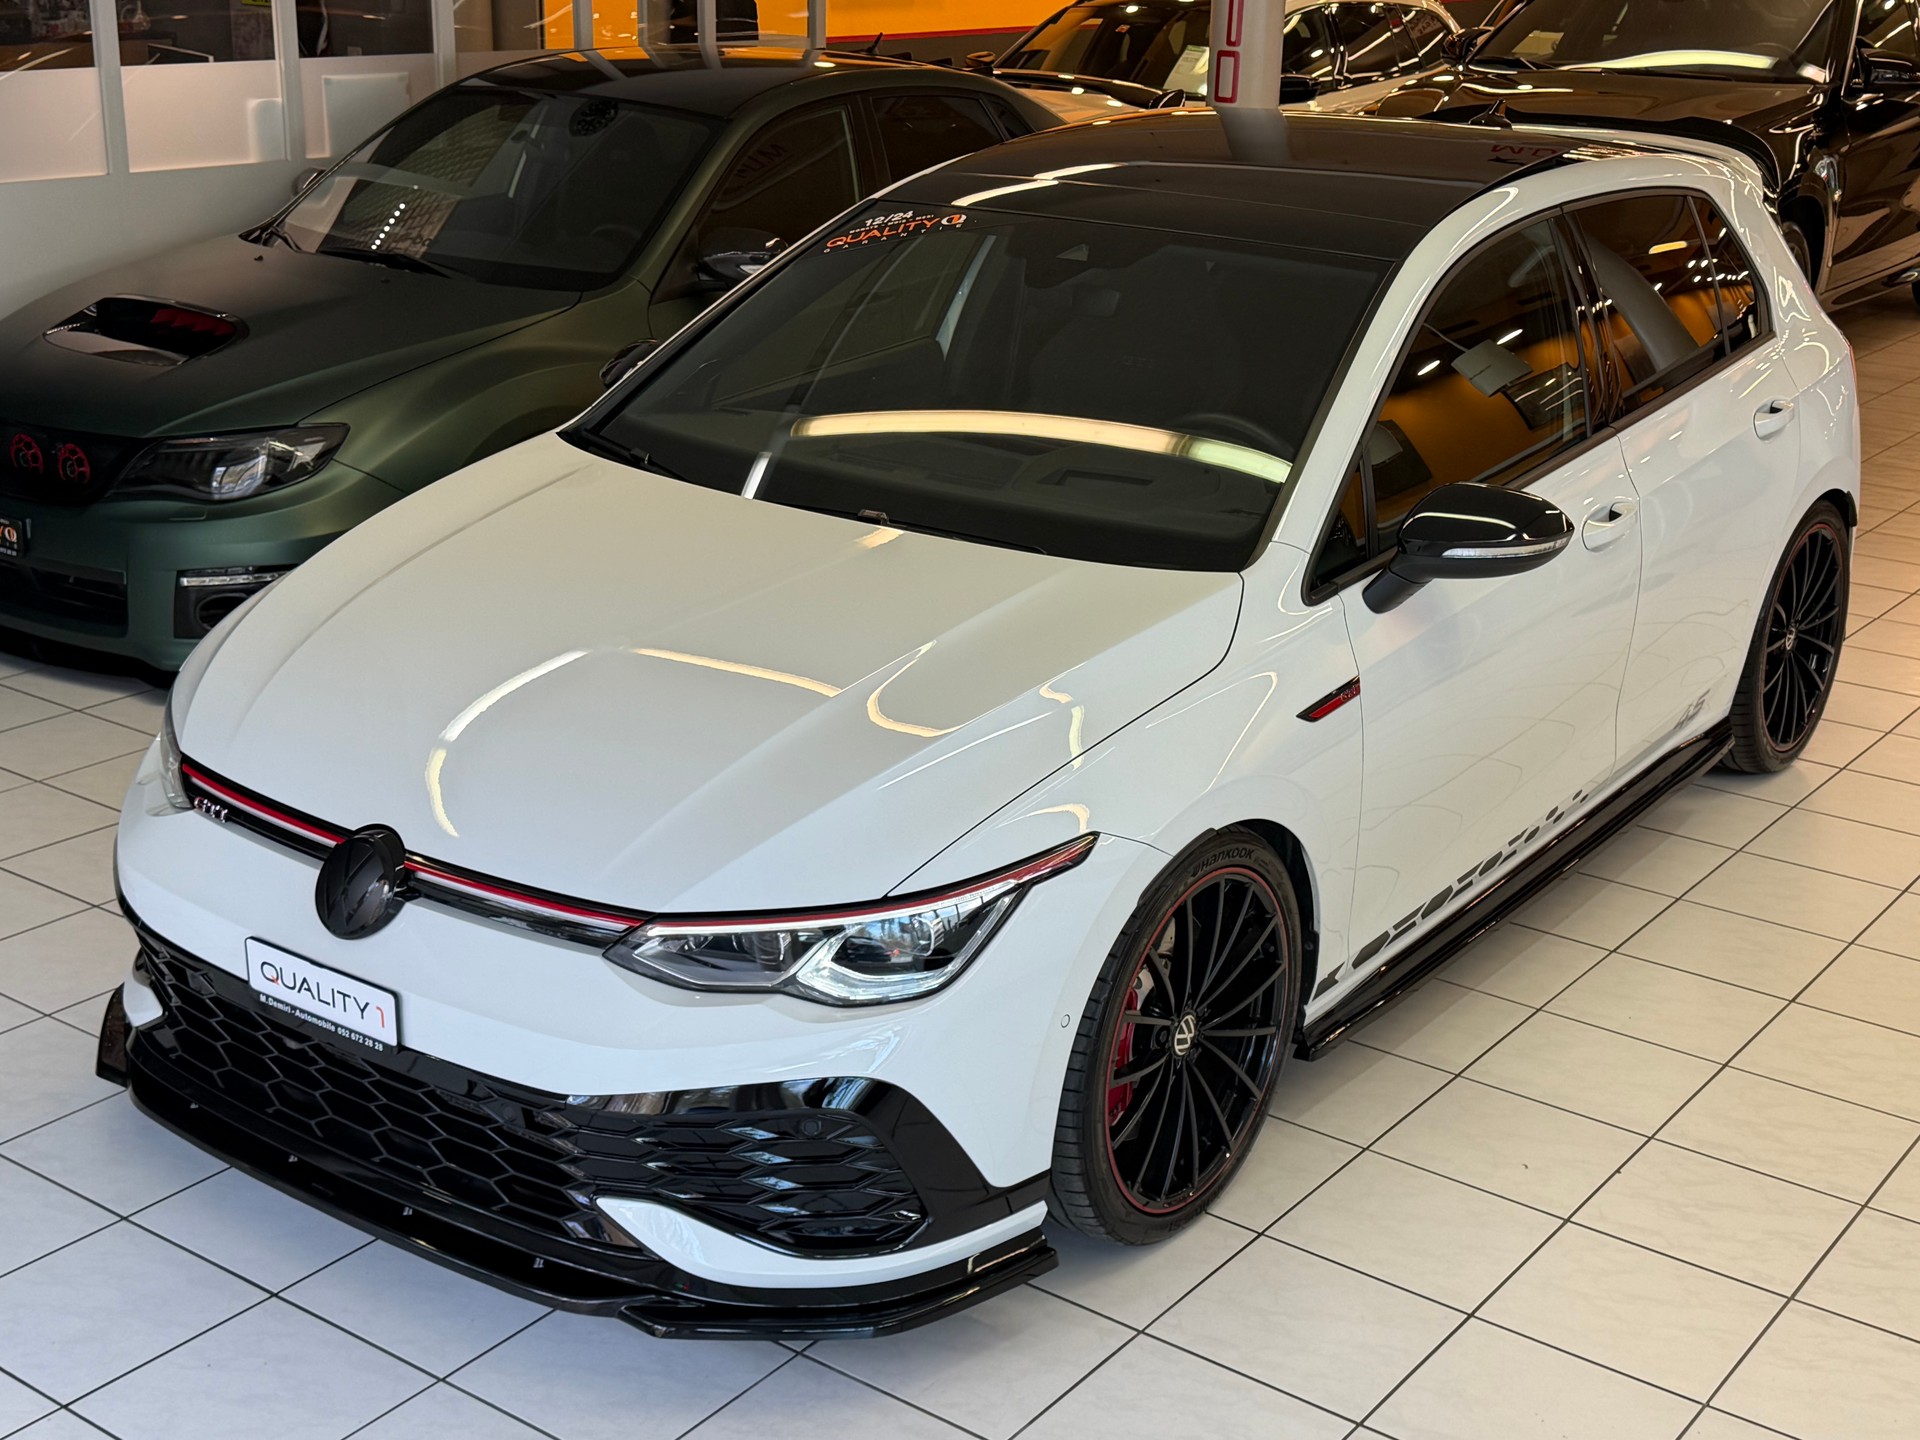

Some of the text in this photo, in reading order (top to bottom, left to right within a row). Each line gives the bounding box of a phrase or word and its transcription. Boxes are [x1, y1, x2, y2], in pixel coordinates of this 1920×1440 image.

[826, 217, 941, 248] QUALITY
[865, 210, 914, 227] 12/24
[260, 961, 370, 1020] QUALITY
[295, 1010, 336, 1033] Automobile
[374, 1041, 384, 1052] 28
